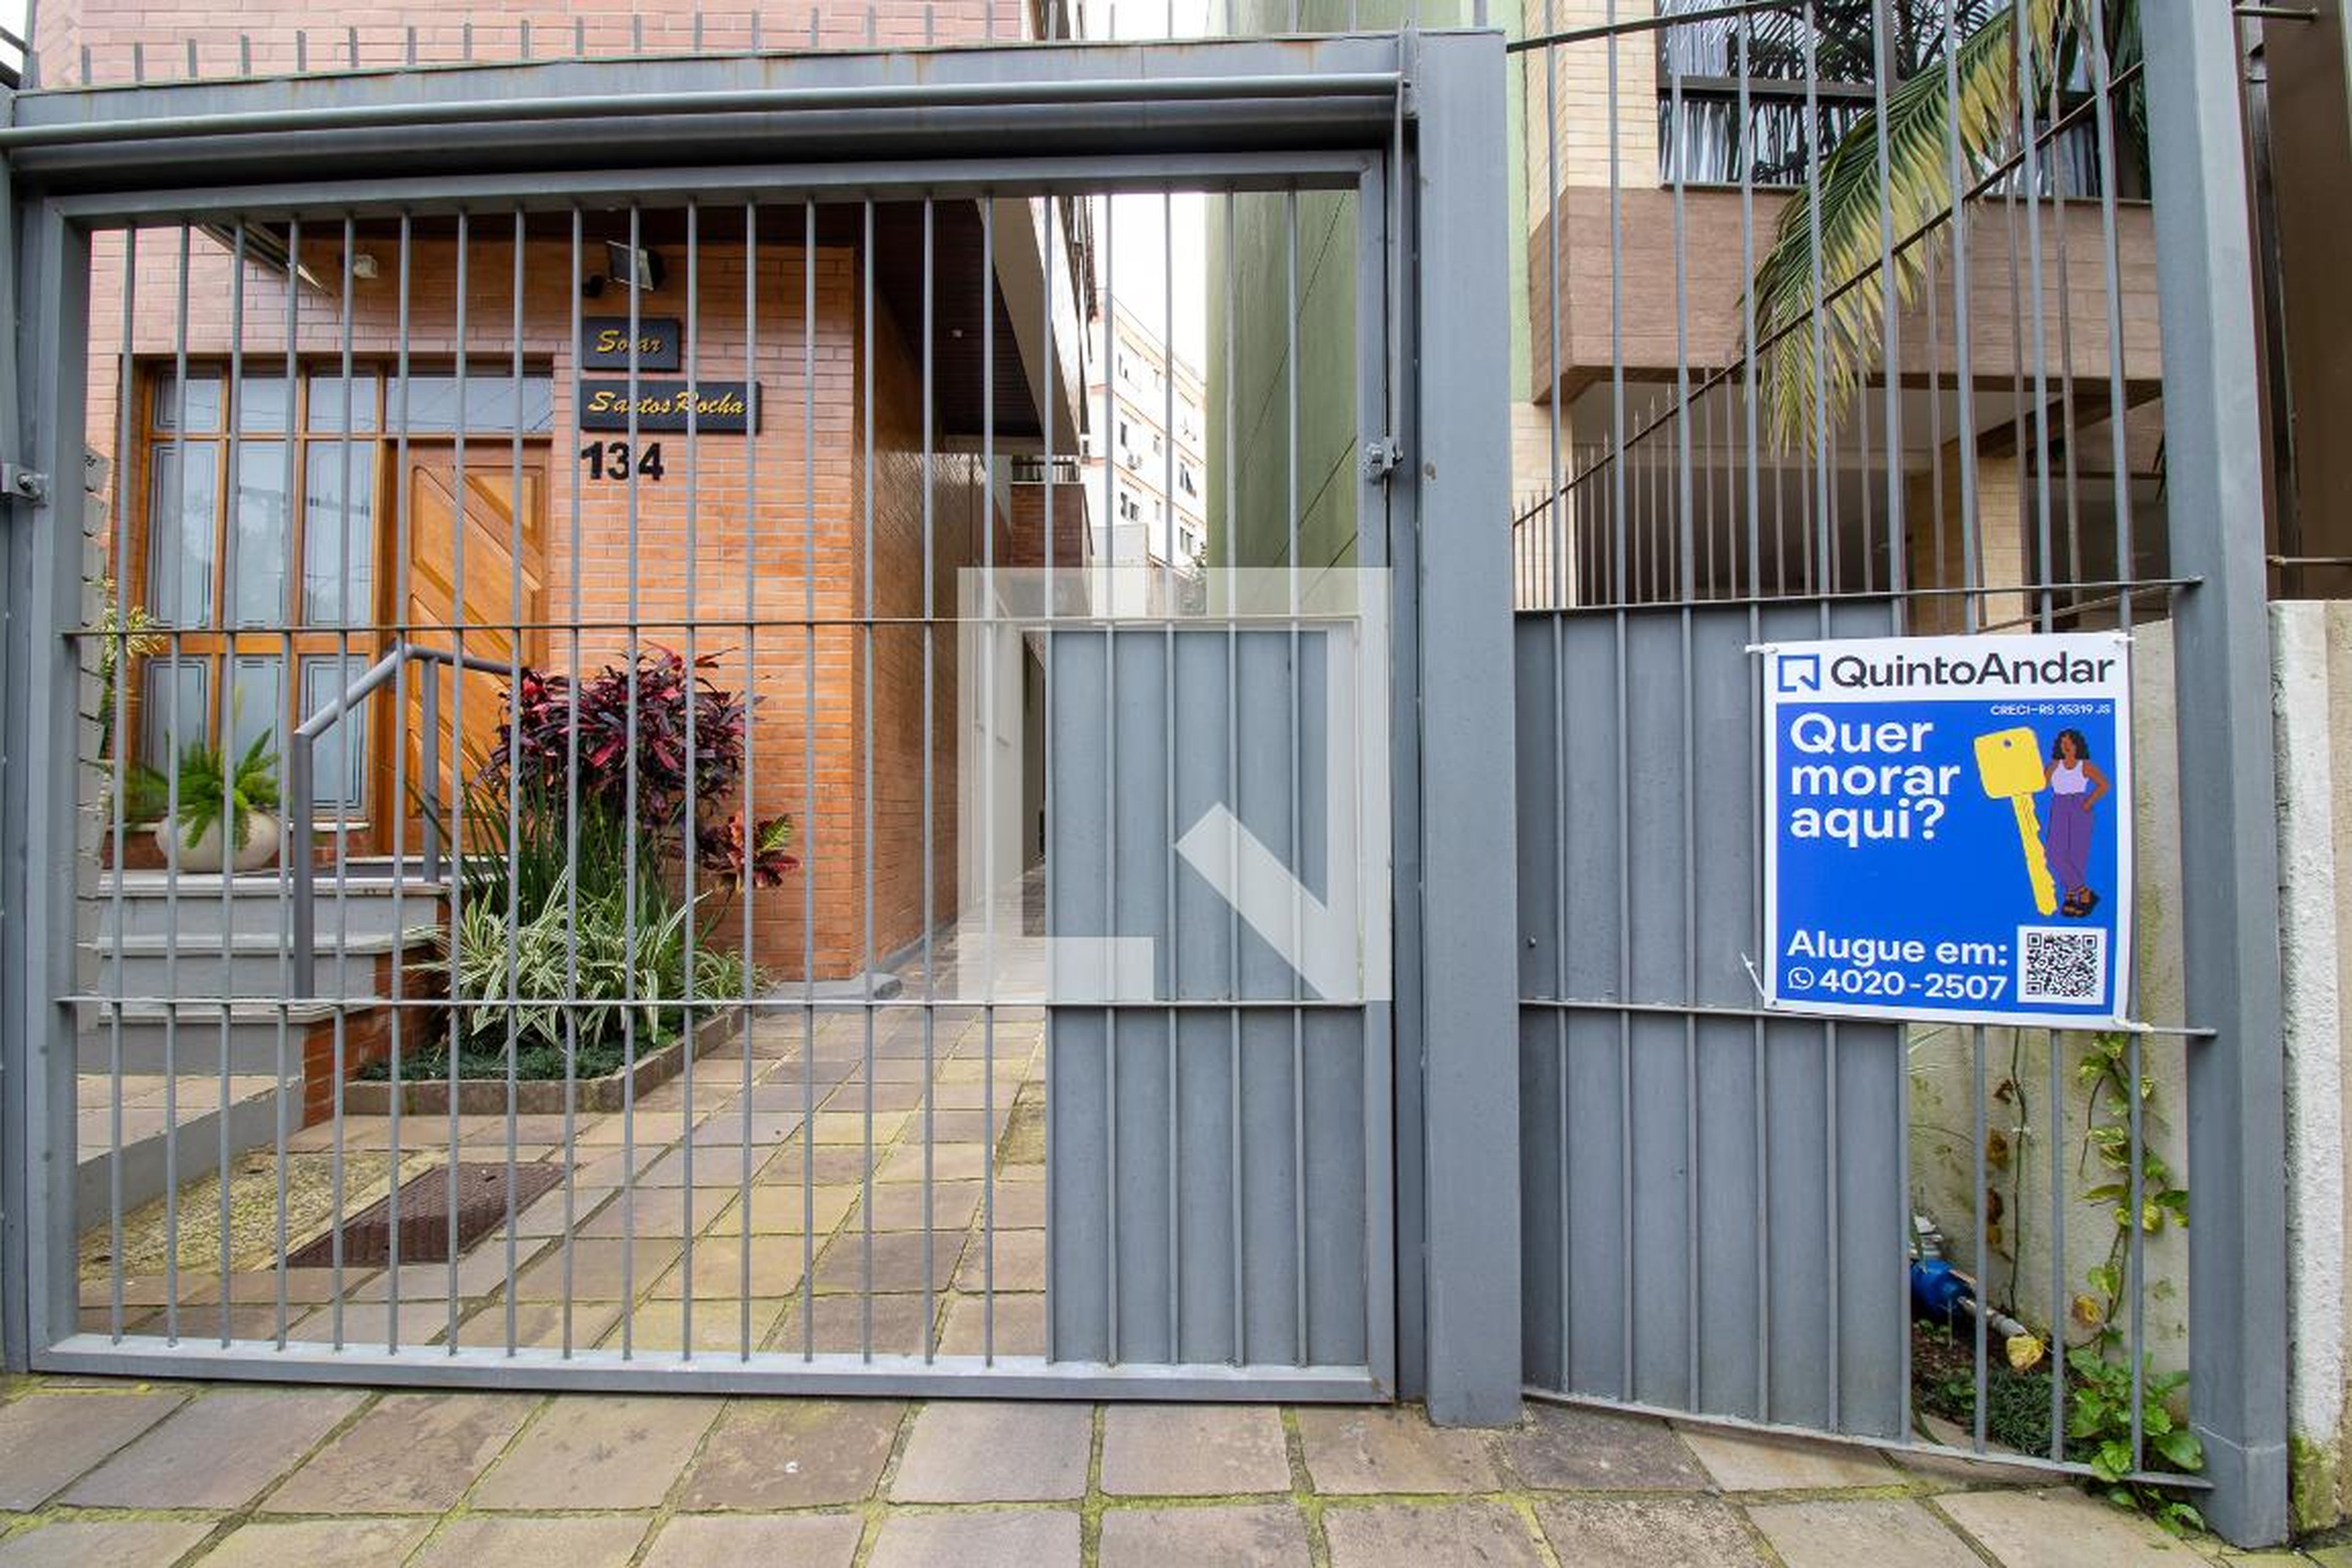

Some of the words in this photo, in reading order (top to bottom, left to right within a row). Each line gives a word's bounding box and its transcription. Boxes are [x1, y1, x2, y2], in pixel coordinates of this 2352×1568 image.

[595, 329, 663, 354] Soar
[588, 391, 673, 415] Satos
[581, 441, 664, 481] 134
[1830, 651, 2115, 689] QuintoAndar
[1790, 712, 1934, 754] Quer
[1792, 764, 1960, 796] morar
[1790, 798, 1945, 848] aqui?
[1786, 930, 1925, 968] Alugue
[1936, 941, 2008, 967] em:
[1819, 968, 2008, 1001] 4020-2507
